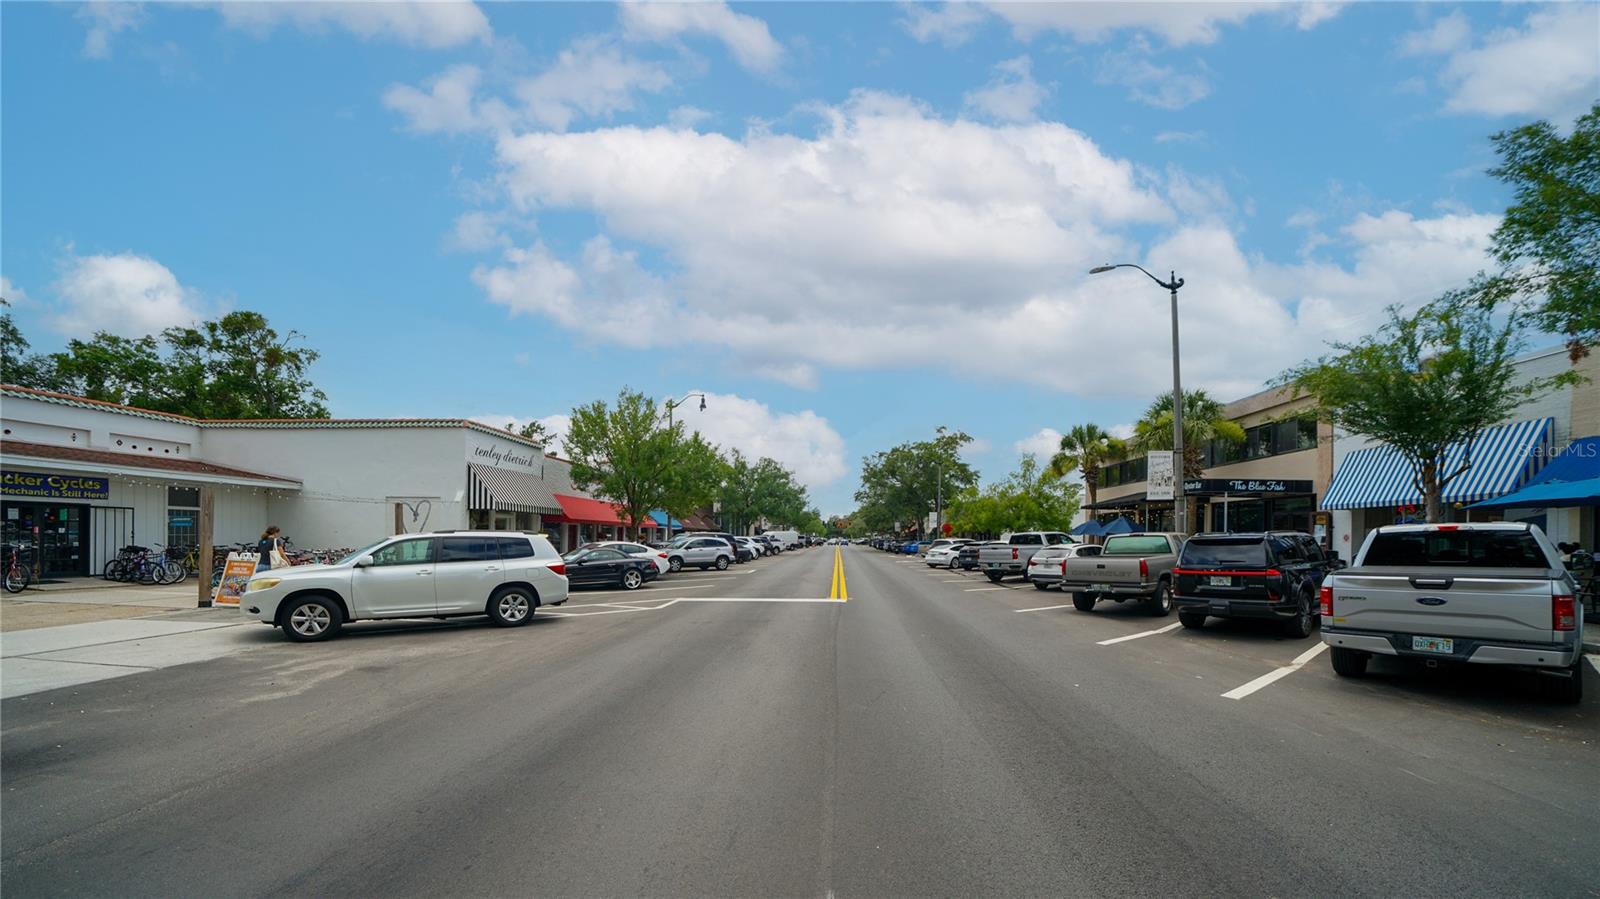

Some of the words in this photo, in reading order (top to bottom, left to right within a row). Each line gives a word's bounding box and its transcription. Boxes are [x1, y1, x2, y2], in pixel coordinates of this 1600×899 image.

[48, 476, 101, 490] Cycles
[1229, 480, 1247, 491] The
[1248, 480, 1266, 491] Blue
[1266, 481, 1286, 491] Fish
[0, 487, 49, 497] Mechanic
[62, 490, 81, 498] Still
[84, 491, 109, 499] Here!
